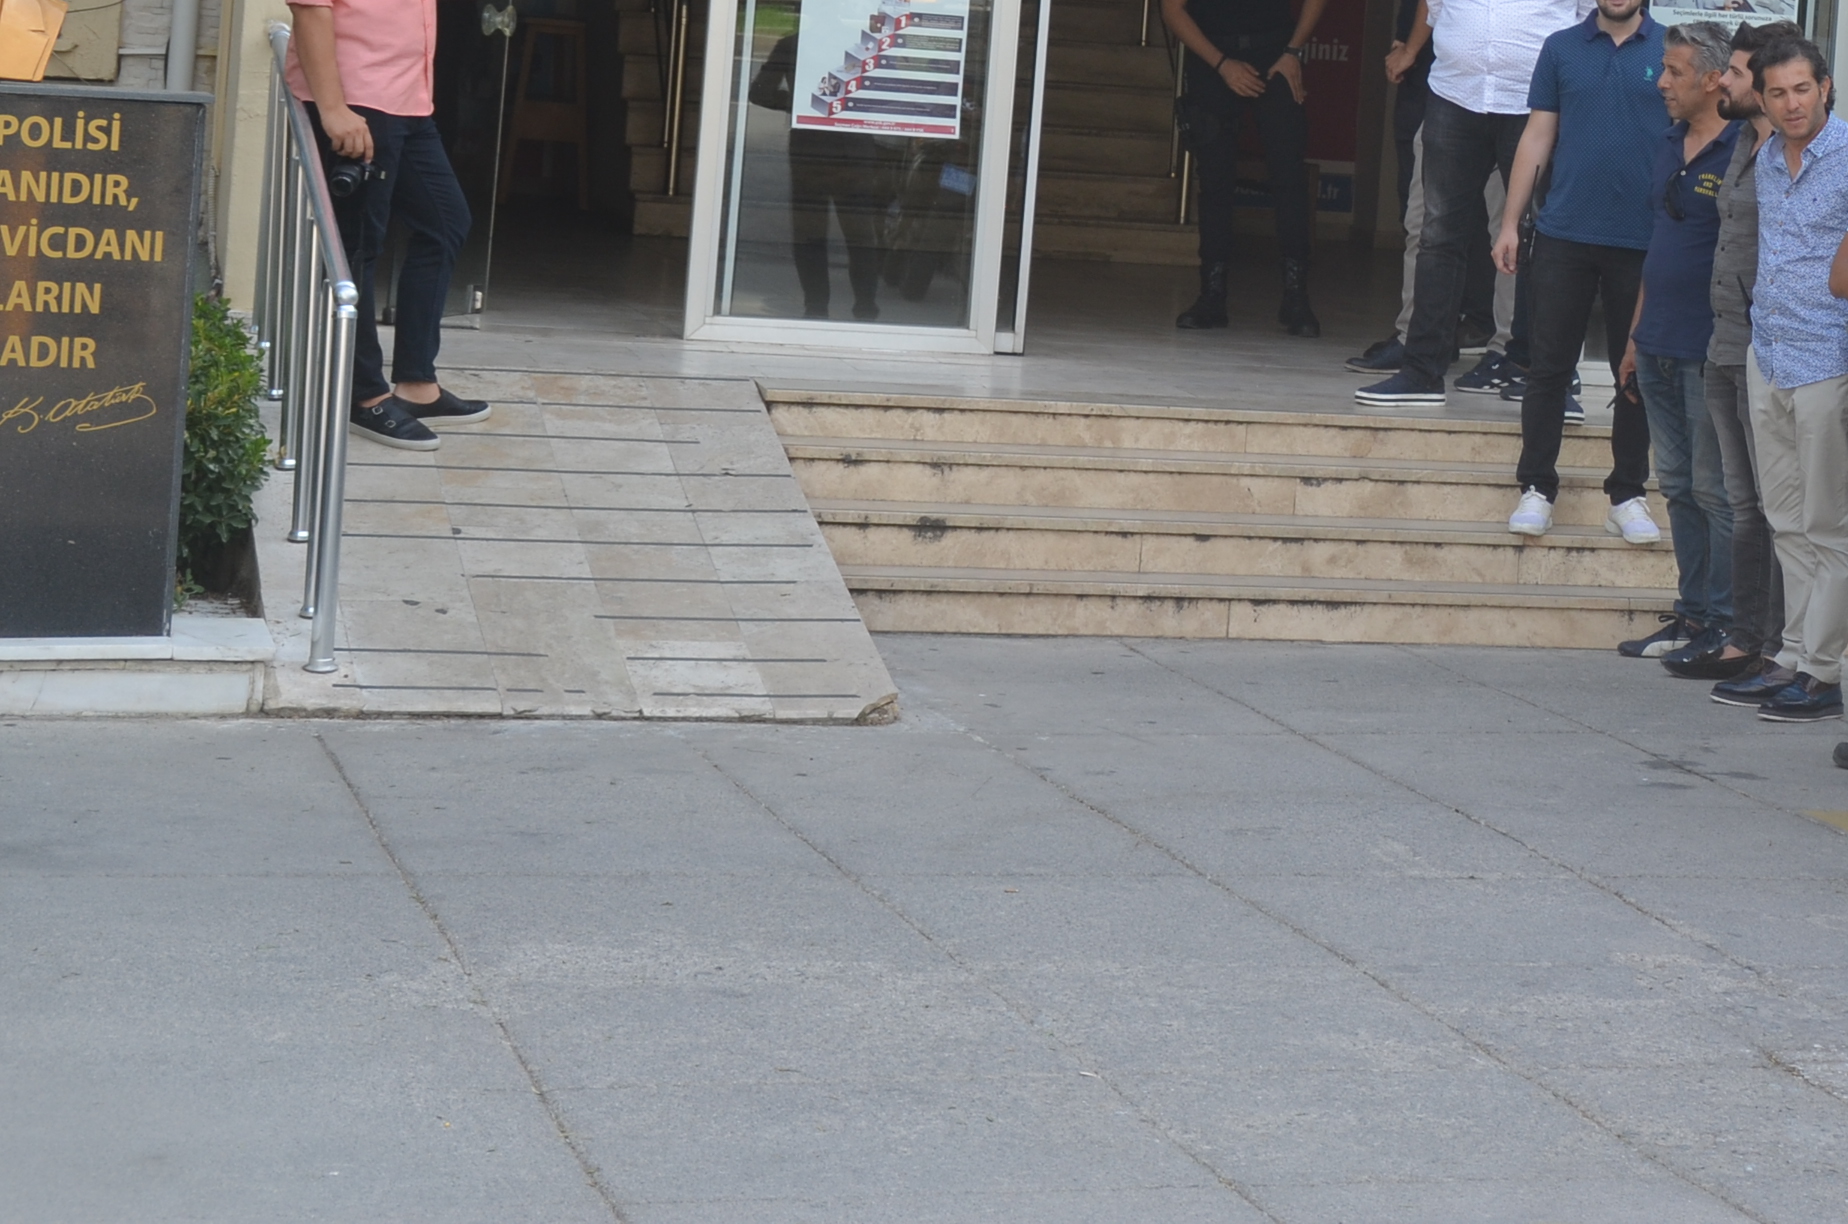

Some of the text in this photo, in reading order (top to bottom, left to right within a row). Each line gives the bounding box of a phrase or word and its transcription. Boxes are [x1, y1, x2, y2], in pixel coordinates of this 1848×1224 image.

[899, 15, 906, 28] 1
[1672, 9, 1703, 17] Seçimlerle
[1703, 10, 1717, 19] ilgili
[1728, 12, 1744, 20] türlü
[1744, 14, 1773, 22] sorunuza
[881, 37, 891, 50] 2
[865, 58, 875, 71] 3
[847, 80, 857, 93] 4
[832, 101, 842, 114] 5
[0, 111, 122, 152] POLİSİ
[0, 169, 139, 211] ANIDIR,
[0, 218, 164, 262] VİCDANI
[0, 280, 102, 314] ARIN
[0, 335, 97, 369] ADIR
